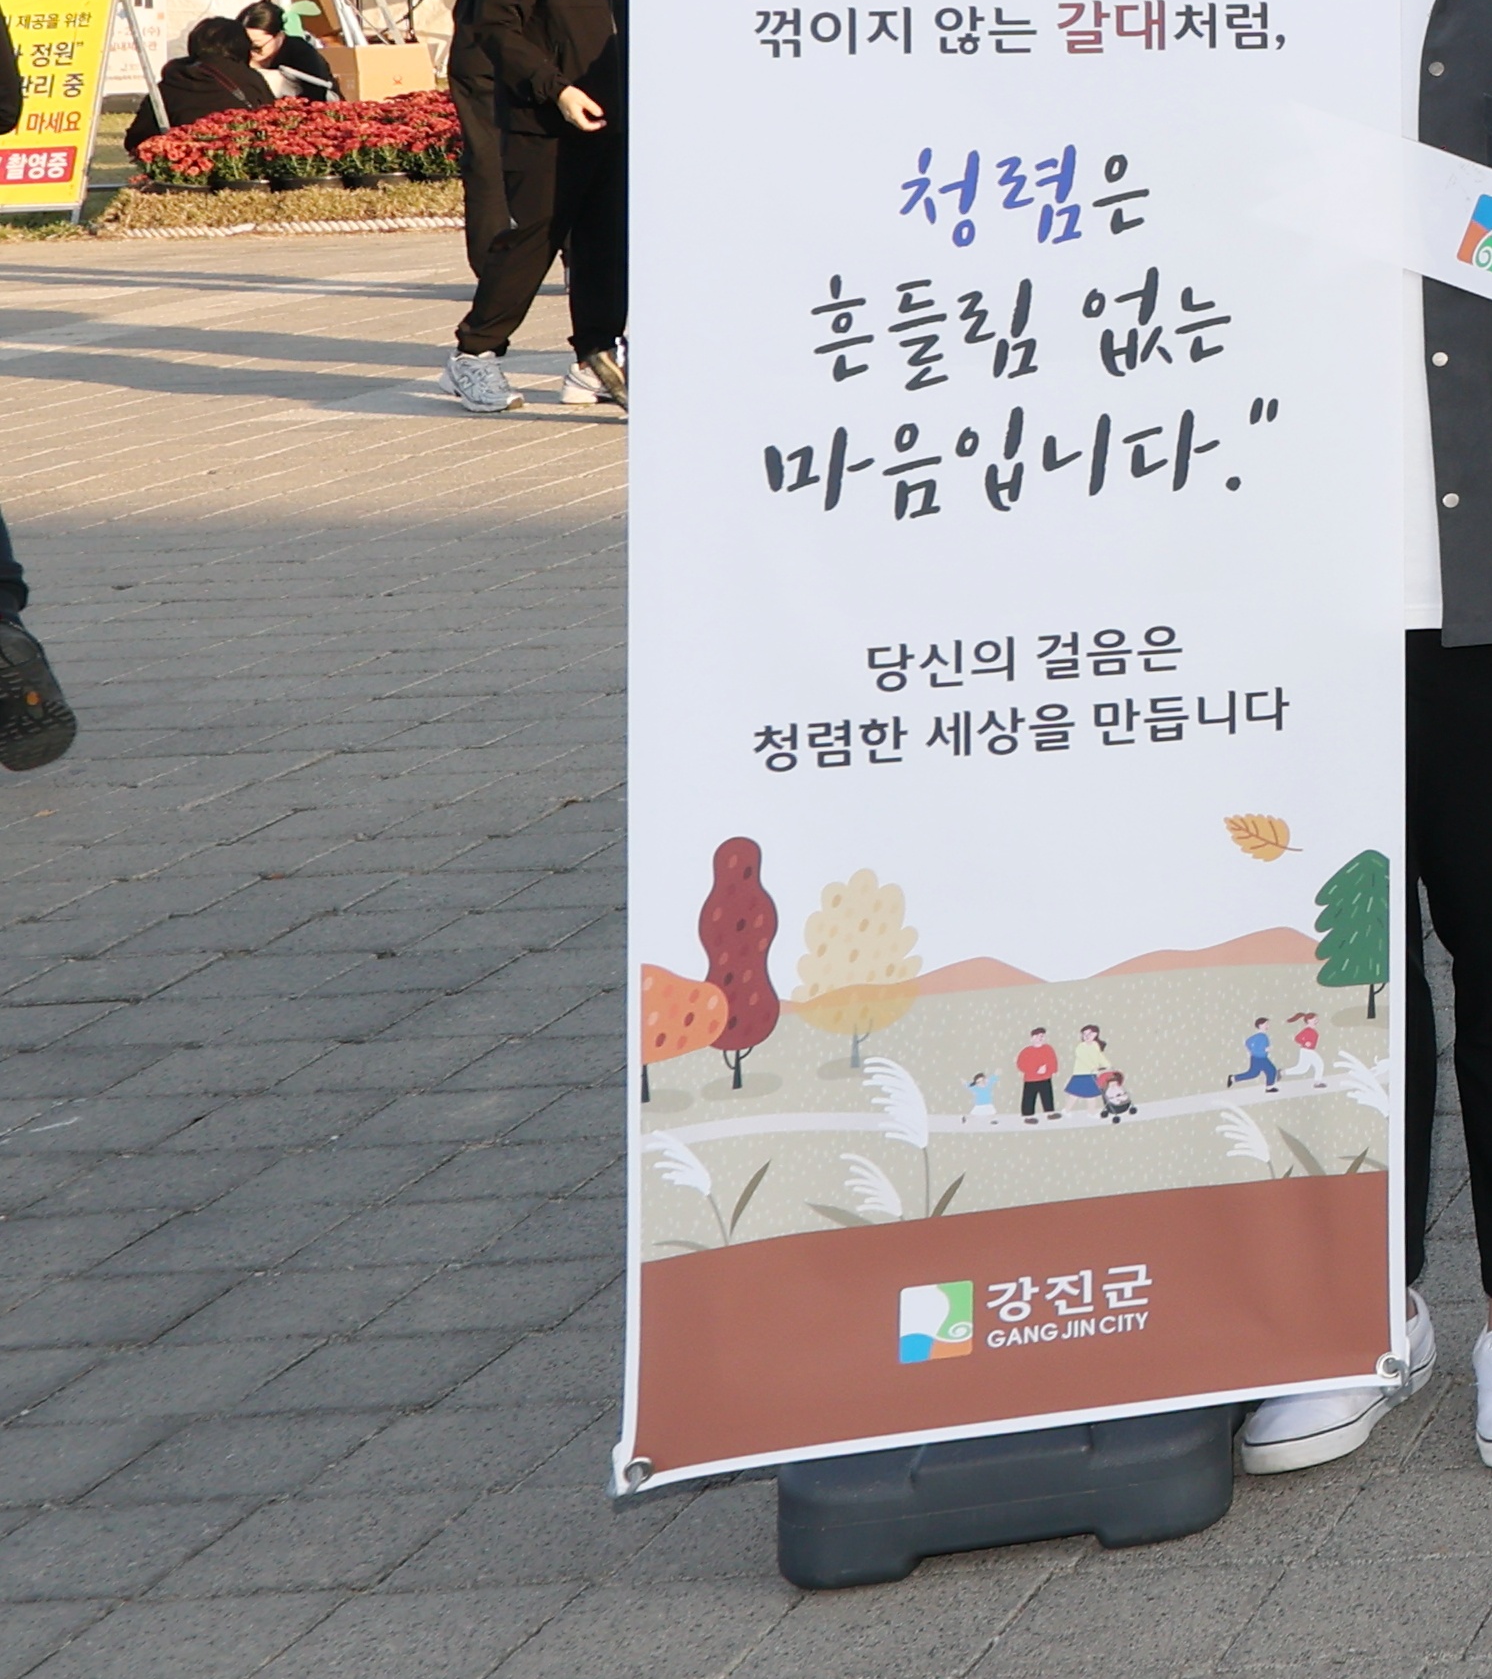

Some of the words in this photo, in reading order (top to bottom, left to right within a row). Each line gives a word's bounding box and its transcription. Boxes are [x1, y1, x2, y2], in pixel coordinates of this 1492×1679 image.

[16, 13, 60, 30] 제공을
[64, 12, 92, 28] 위한
[753, 6, 912, 58] 꺾이지
[934, 5, 1037, 55] 않는
[1056, 0, 1286, 54] 갈대처럼,
[63, 73, 84, 98] 중
[27, 111, 81, 135] 마세요
[6, 151, 68, 181] 촬영중
[900, 144, 1150, 247] 청렴은
[811, 274, 1038, 391] 흔들림
[1081, 266, 1232, 377] 없는
[866, 635, 1017, 693] 당신의
[1035, 624, 1184, 682] 걸음은
[751, 715, 908, 773] 청렴한
[925, 702, 1075, 758] 세상을
[1093, 687, 1290, 748] 만듭니다
[986, 1263, 1153, 1323] 강진군
[986, 1322, 1057, 1348] GANG
[1060, 1318, 1097, 1341] JIN
[1098, 1311, 1149, 1335] CITY
